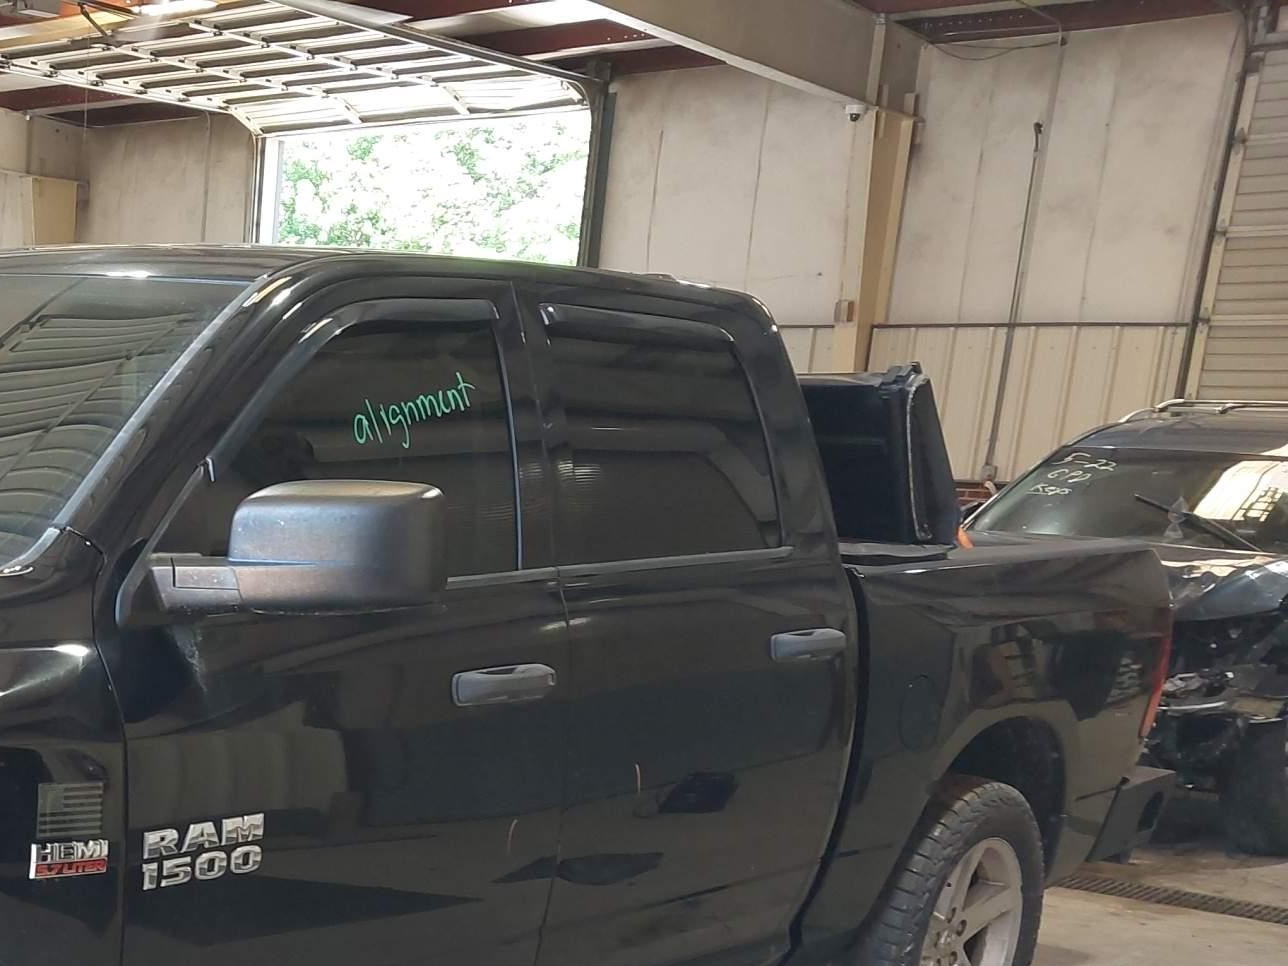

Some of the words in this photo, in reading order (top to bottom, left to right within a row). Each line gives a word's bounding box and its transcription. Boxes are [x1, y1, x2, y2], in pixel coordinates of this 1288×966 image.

[353, 371, 477, 449] alignment
[32, 839, 110, 864] HEMI
[143, 812, 265, 860] RAM
[36, 861, 61, 876] 5.7
[62, 858, 107, 874] LITER
[141, 845, 263, 891] 1500
